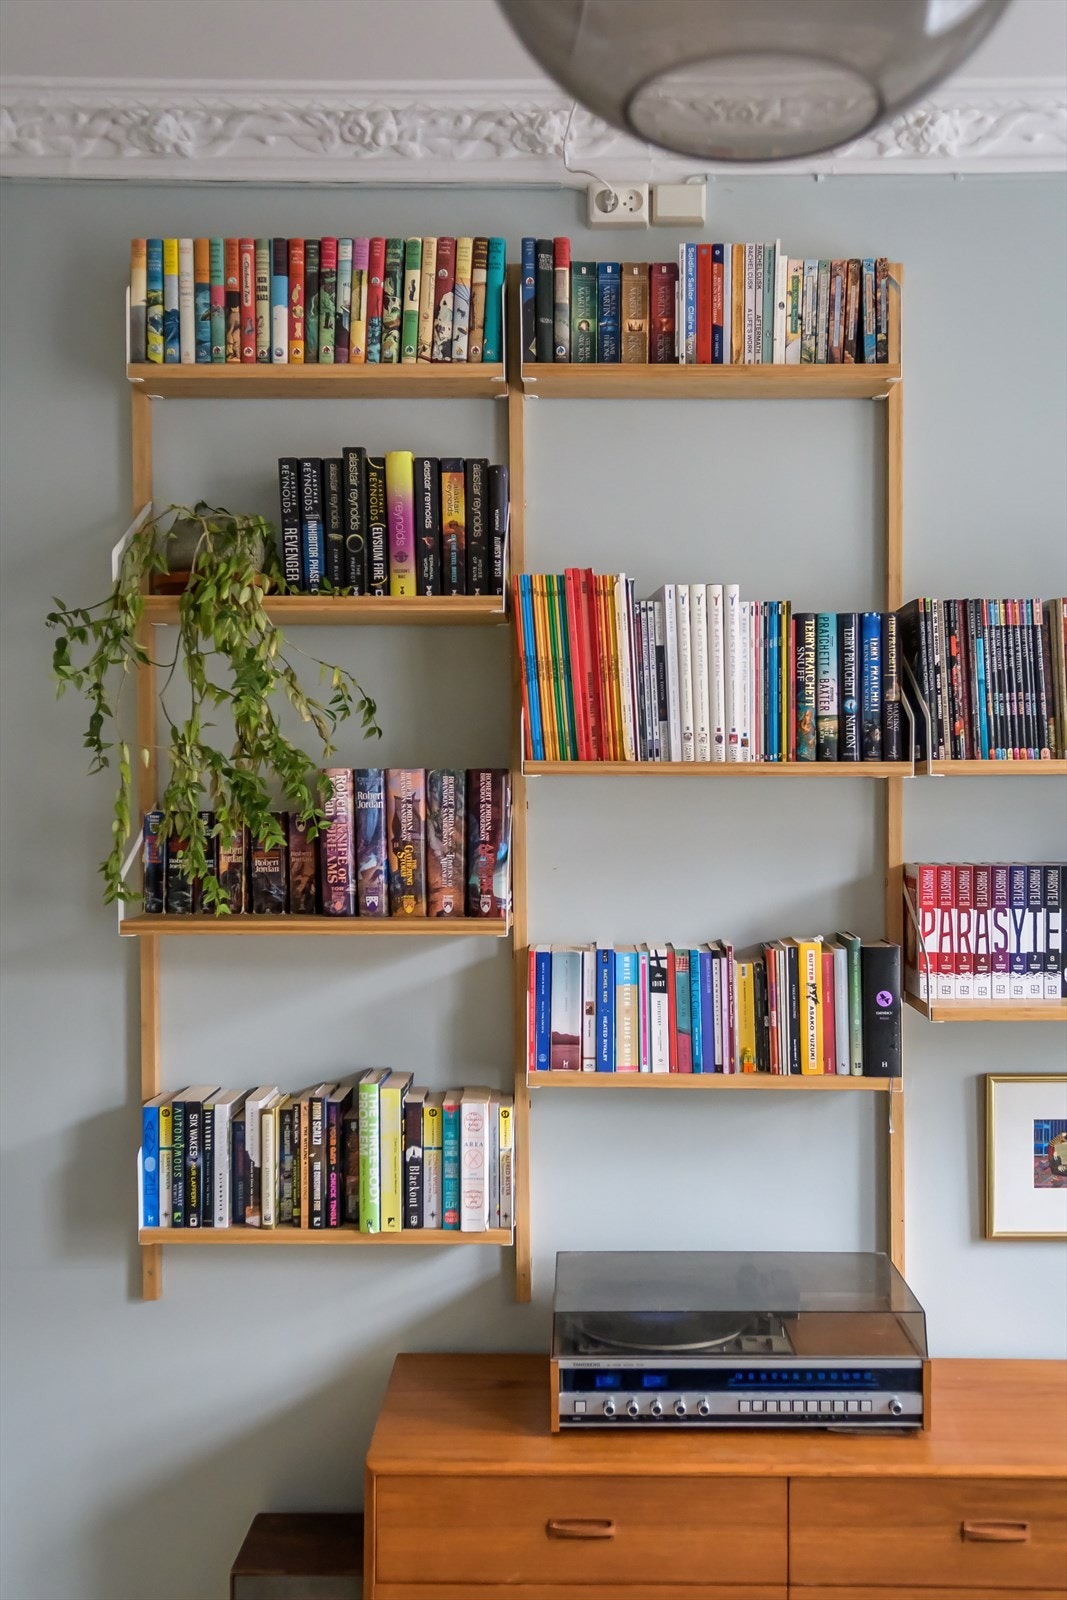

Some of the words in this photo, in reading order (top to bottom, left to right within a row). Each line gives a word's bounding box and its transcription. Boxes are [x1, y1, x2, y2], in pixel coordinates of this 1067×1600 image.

[243, 261, 251, 288] Clockwork
[578, 286, 586, 317] MARTIN
[658, 286, 666, 317] MARTIN
[628, 336, 636, 362] KINGS
[657, 334, 666, 361] CROWS
[686, 332, 694, 354] Kilroy
[348, 452, 358, 486] alastair
[424, 460, 432, 490] alastair
[472, 464, 482, 495] alastair
[281, 464, 290, 514] REYNOLDS
[303, 462, 312, 512] REYNOLDS
[370, 472, 378, 521] REYNOLDS
[447, 480, 455, 516] reynolds
[330, 494, 340, 530] reynolds
[348, 488, 360, 530] reynolds
[394, 502, 406, 546] reynolds
[424, 492, 433, 528] reynolds
[472, 498, 483, 538] reynolds
[308, 520, 318, 556] INHIBITOR
[372, 526, 383, 561] ELYSIUM
[284, 527, 300, 581] REVENGER
[310, 559, 320, 583] PHASE
[374, 563, 384, 580] FIRE
[806, 619, 816, 650] TERRY
[819, 617, 830, 667] PRATCHETT
[846, 627, 855, 652] TERRY
[870, 638, 880, 661] TERRY
[797, 646, 805, 682] SNUFF
[845, 653, 855, 696] PRATCHETT
[806, 652, 816, 708] PRATCHETT
[820, 678, 830, 712] BAXTER
[870, 666, 880, 712] PRATCHETT
[846, 715, 856, 748] NATION
[336, 774, 348, 816] Robert
[358, 791, 384, 800] Robert
[358, 800, 384, 808] Jordan
[327, 828, 338, 884] DREAMS
[338, 824, 348, 866] KNIFE
[338, 868, 347, 884] OF
[397, 852, 406, 878] STORM
[404, 844, 414, 886] GATHERING
[440, 857, 448, 888] MIDNIGHT
[446, 852, 456, 878] TOWERS
[923, 870, 933, 900] PARASYTE
[941, 870, 951, 900] PARASYTE
[959, 870, 970, 900] PARASYTE
[976, 872, 987, 902] PARASYTE
[996, 870, 1006, 900] PARASYTE
[1013, 870, 1024, 900] PARASYTE
[1030, 870, 1040, 899] PARASYTE
[1047, 870, 1058, 899] PARASYTE
[921, 908, 1060, 954] PARASYTE
[691, 954, 699, 979] Ursula
[691, 1000, 700, 1020] Guin
[312, 1102, 322, 1120] JOHN
[369, 1092, 378, 1118] THE
[190, 1114, 199, 1128] SIX
[313, 1121, 322, 1145] SCALZI
[360, 1093, 368, 1156] PROBLEM
[173, 1108, 184, 1178] AUTONOMOUS
[190, 1129, 199, 1156] WAKES
[369, 1122, 380, 1205] THREE-BODY
[408, 1166, 420, 1208] Blackout
